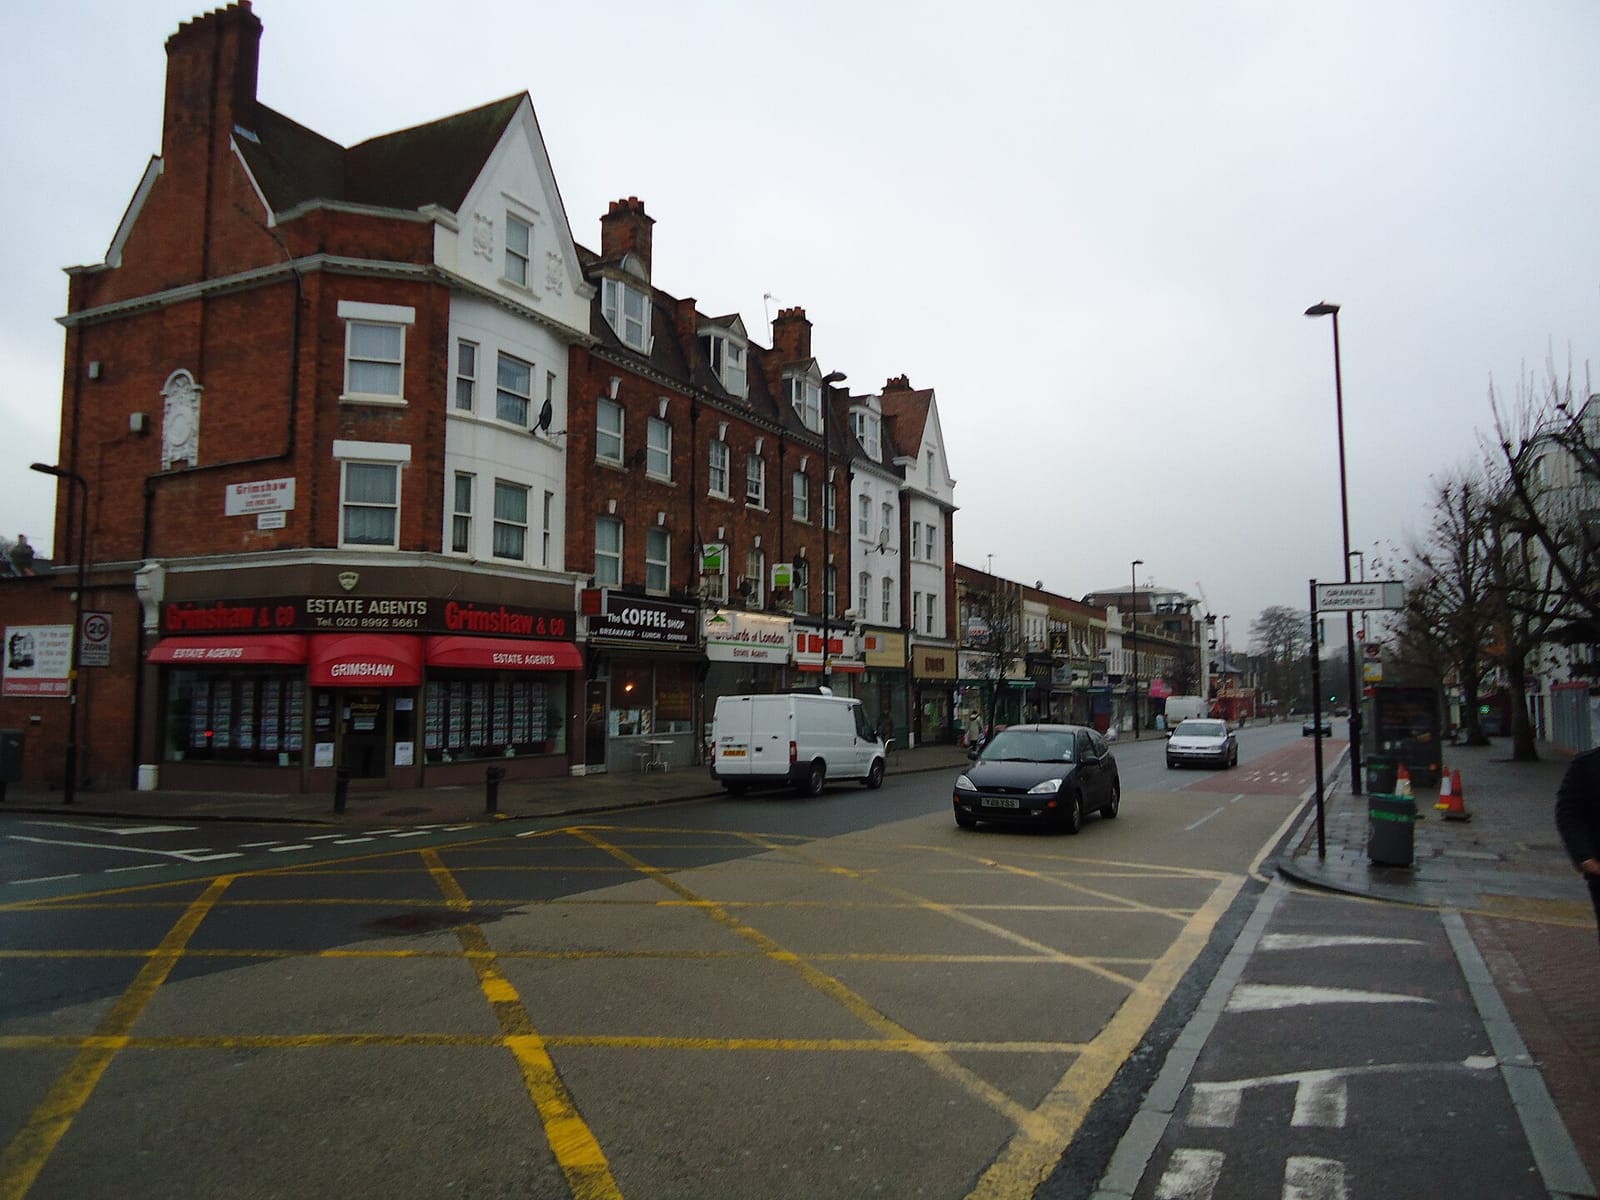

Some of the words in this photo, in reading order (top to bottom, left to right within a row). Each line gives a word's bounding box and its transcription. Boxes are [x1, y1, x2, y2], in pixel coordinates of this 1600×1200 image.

[306, 599, 363, 614] ESTATE
[368, 600, 427, 615] AGENTS
[166, 602, 256, 630] Grimshaw
[336, 617, 358, 627] 020
[361, 618, 389, 628] 8992
[446, 601, 534, 634] Grimshaw
[536, 617, 546, 635] &
[621, 607, 667, 629] COFFEE
[88, 622, 105, 634] 20
[172, 648, 206, 659] ESTATE
[206, 648, 244, 659] AGENTS
[493, 653, 524, 664] ESTATE
[525, 655, 556, 665] AGENTS
[331, 662, 395, 677] GRIMSHAW
